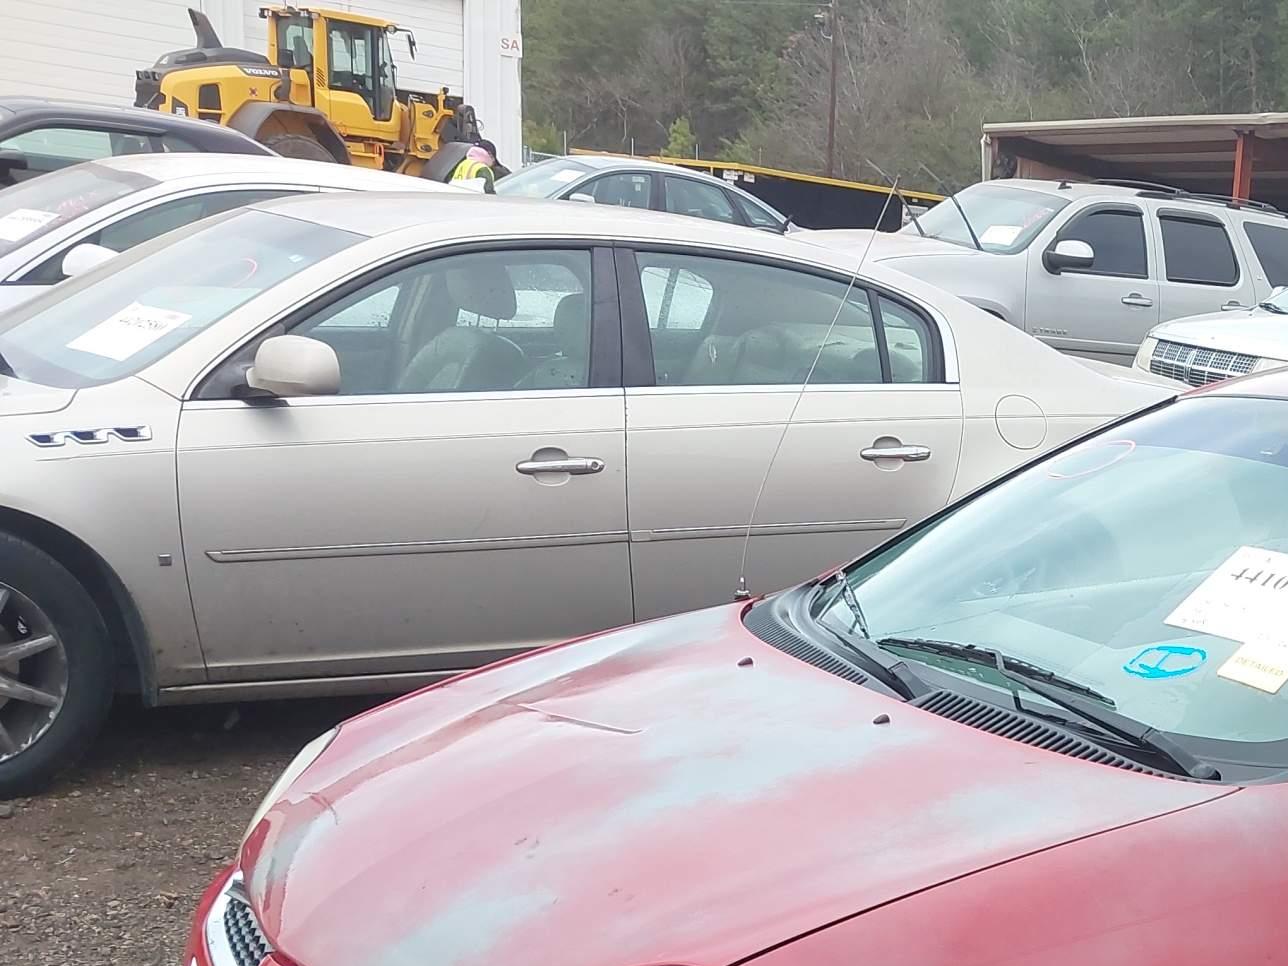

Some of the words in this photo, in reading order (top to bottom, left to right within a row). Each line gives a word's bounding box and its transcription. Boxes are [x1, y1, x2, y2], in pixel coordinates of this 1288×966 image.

[501, 37, 520, 51] SA
[243, 67, 279, 76] VOLVO
[1234, 656, 1285, 677] DETAILED
